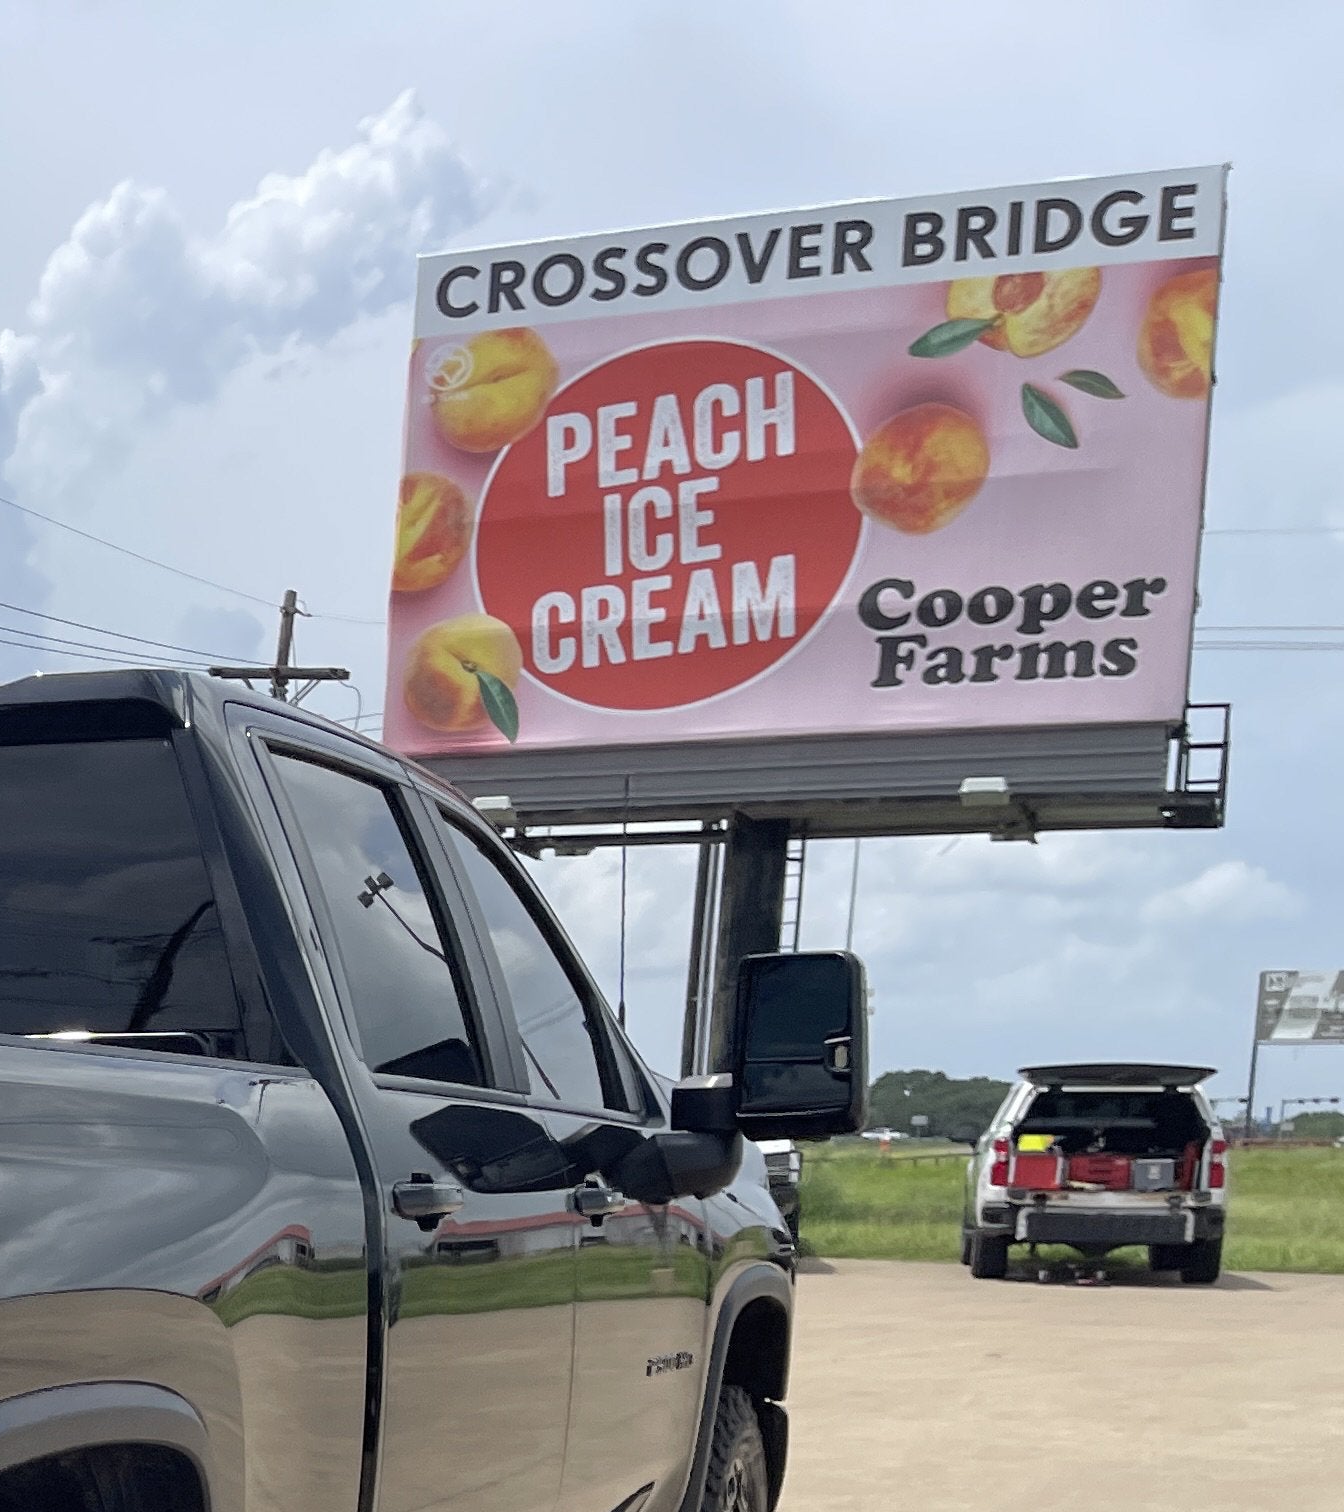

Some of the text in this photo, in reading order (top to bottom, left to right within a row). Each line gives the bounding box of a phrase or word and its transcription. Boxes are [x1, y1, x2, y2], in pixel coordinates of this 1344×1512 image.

[435, 183, 1200, 320] CROSSOVER BRIDGE
[545, 370, 795, 499] PEACH
[601, 476, 723, 578] ICE
[530, 553, 797, 676] CREAM
[857, 574, 1168, 636] Cooper
[869, 634, 1139, 690] Farms
